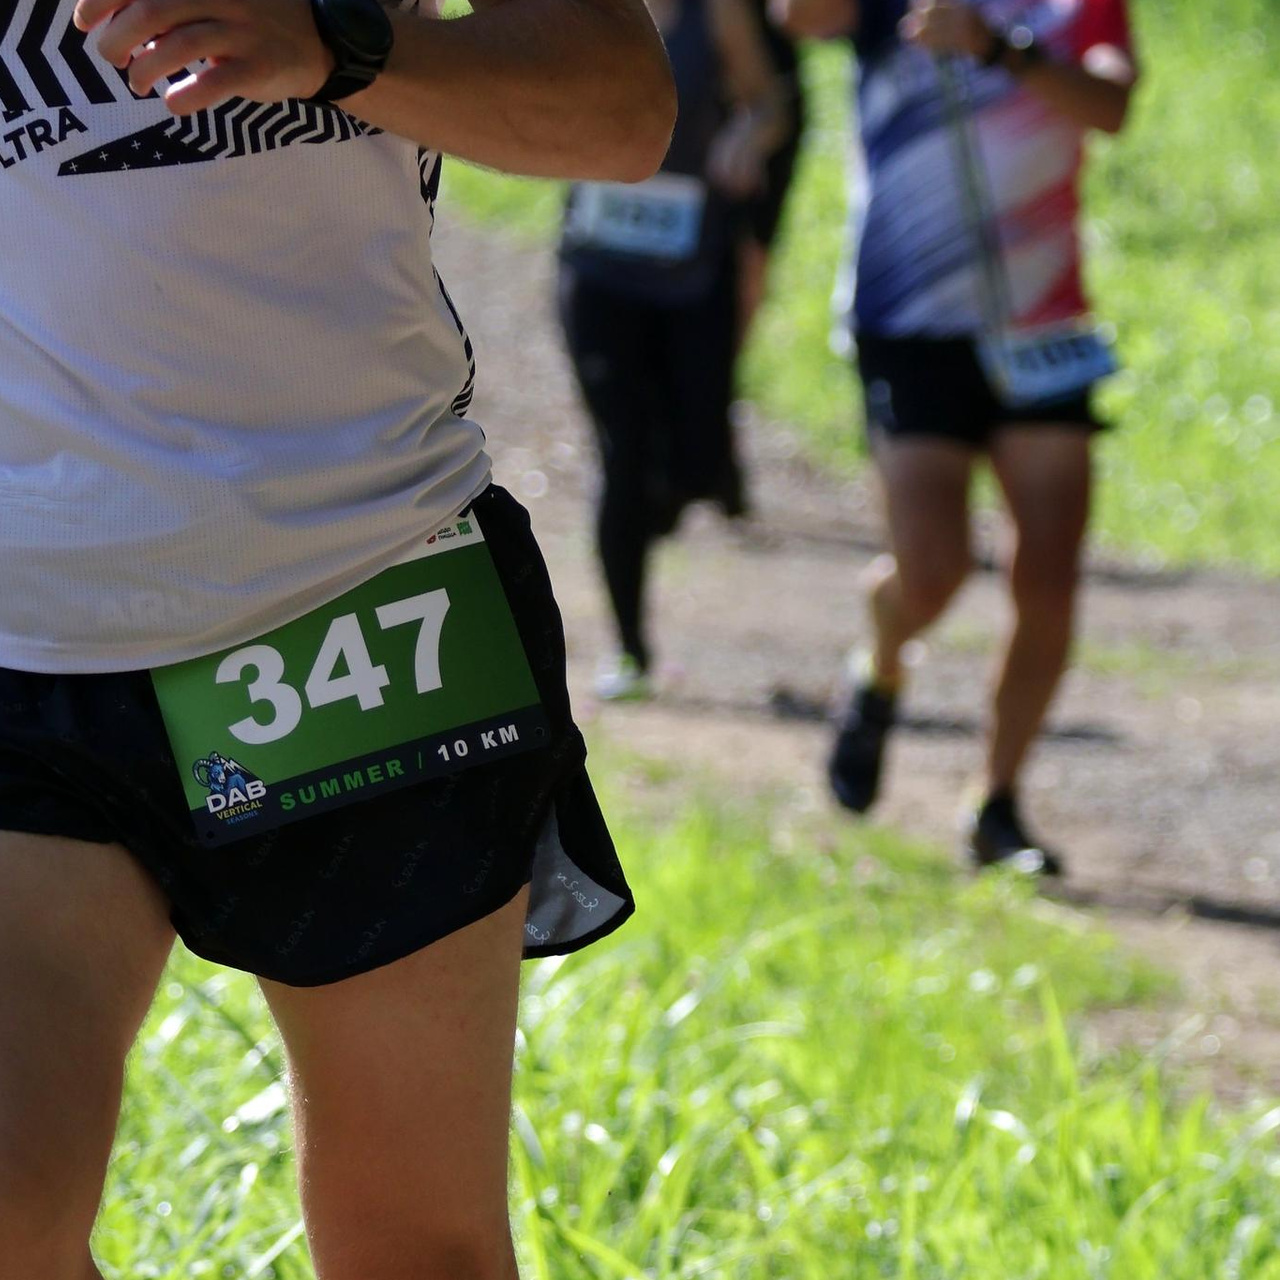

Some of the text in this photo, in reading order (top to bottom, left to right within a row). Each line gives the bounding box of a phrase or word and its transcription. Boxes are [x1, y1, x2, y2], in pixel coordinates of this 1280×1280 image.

[215, 588, 451, 745] 347
[206, 780, 267, 813] DAB
[280, 759, 405, 810] SUMMER
[437, 739, 469, 761] 10
[480, 724, 519, 750] KM
[216, 800, 263, 820] VERTICAL
